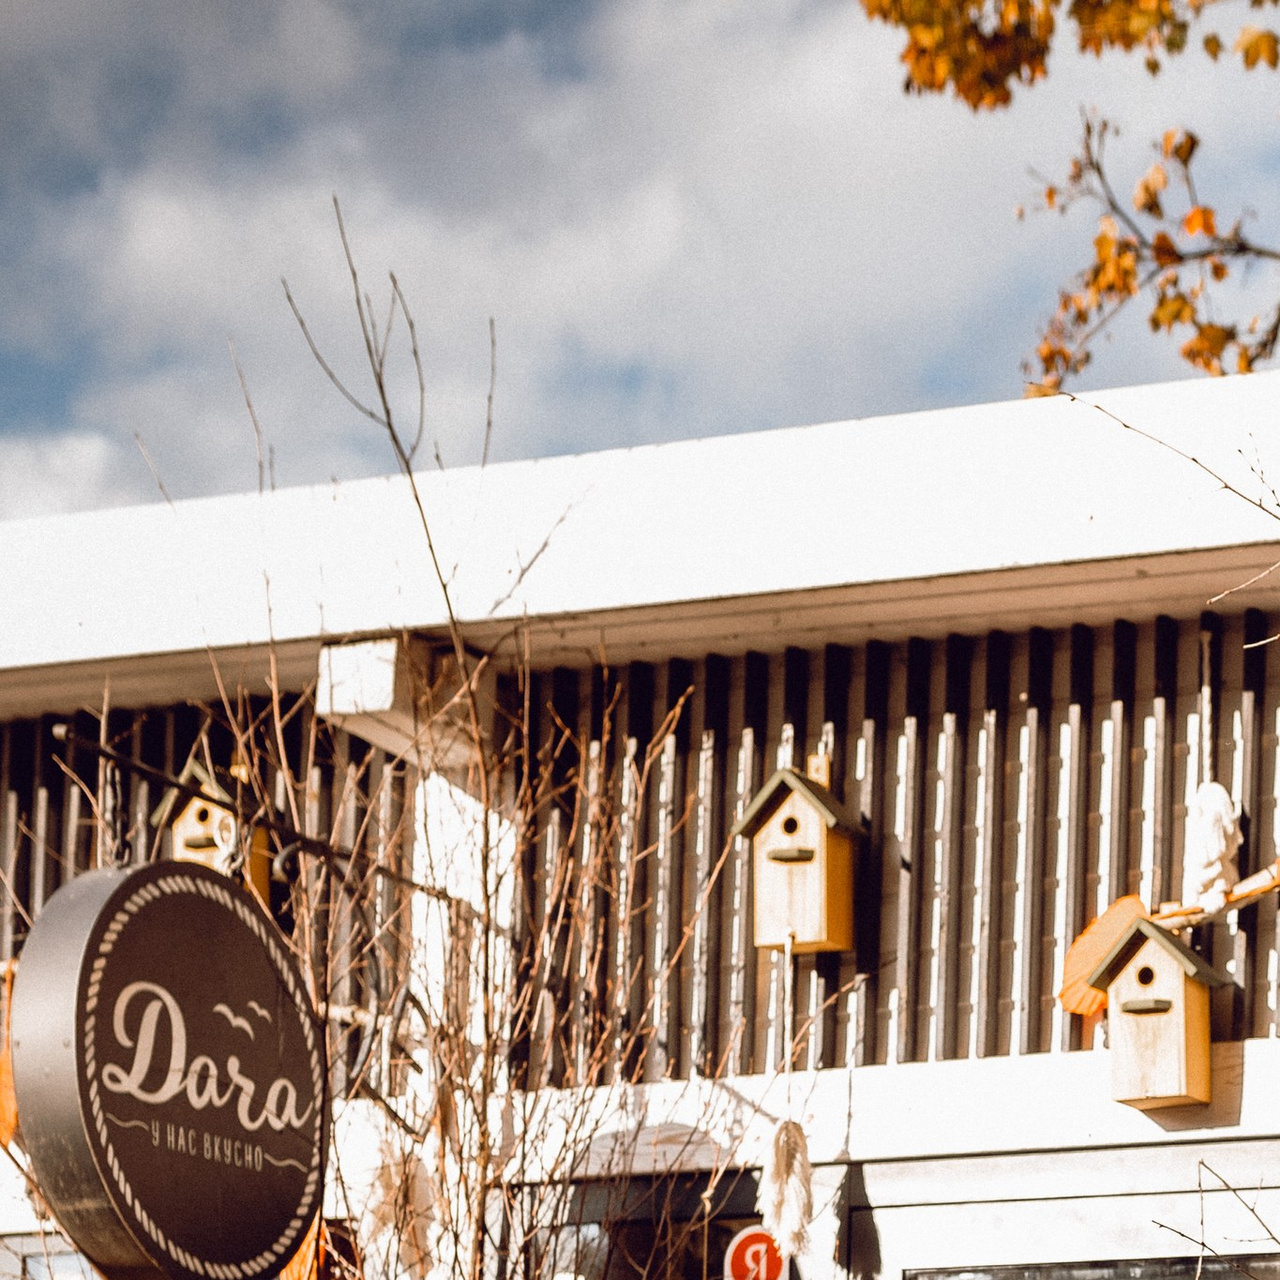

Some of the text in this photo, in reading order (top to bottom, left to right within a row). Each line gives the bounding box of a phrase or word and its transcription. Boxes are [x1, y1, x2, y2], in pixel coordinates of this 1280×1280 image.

[102, 981, 313, 1131] Dara
[166, 1122, 197, 1156] НАС
[203, 1131, 263, 1173] ВКУСНО
